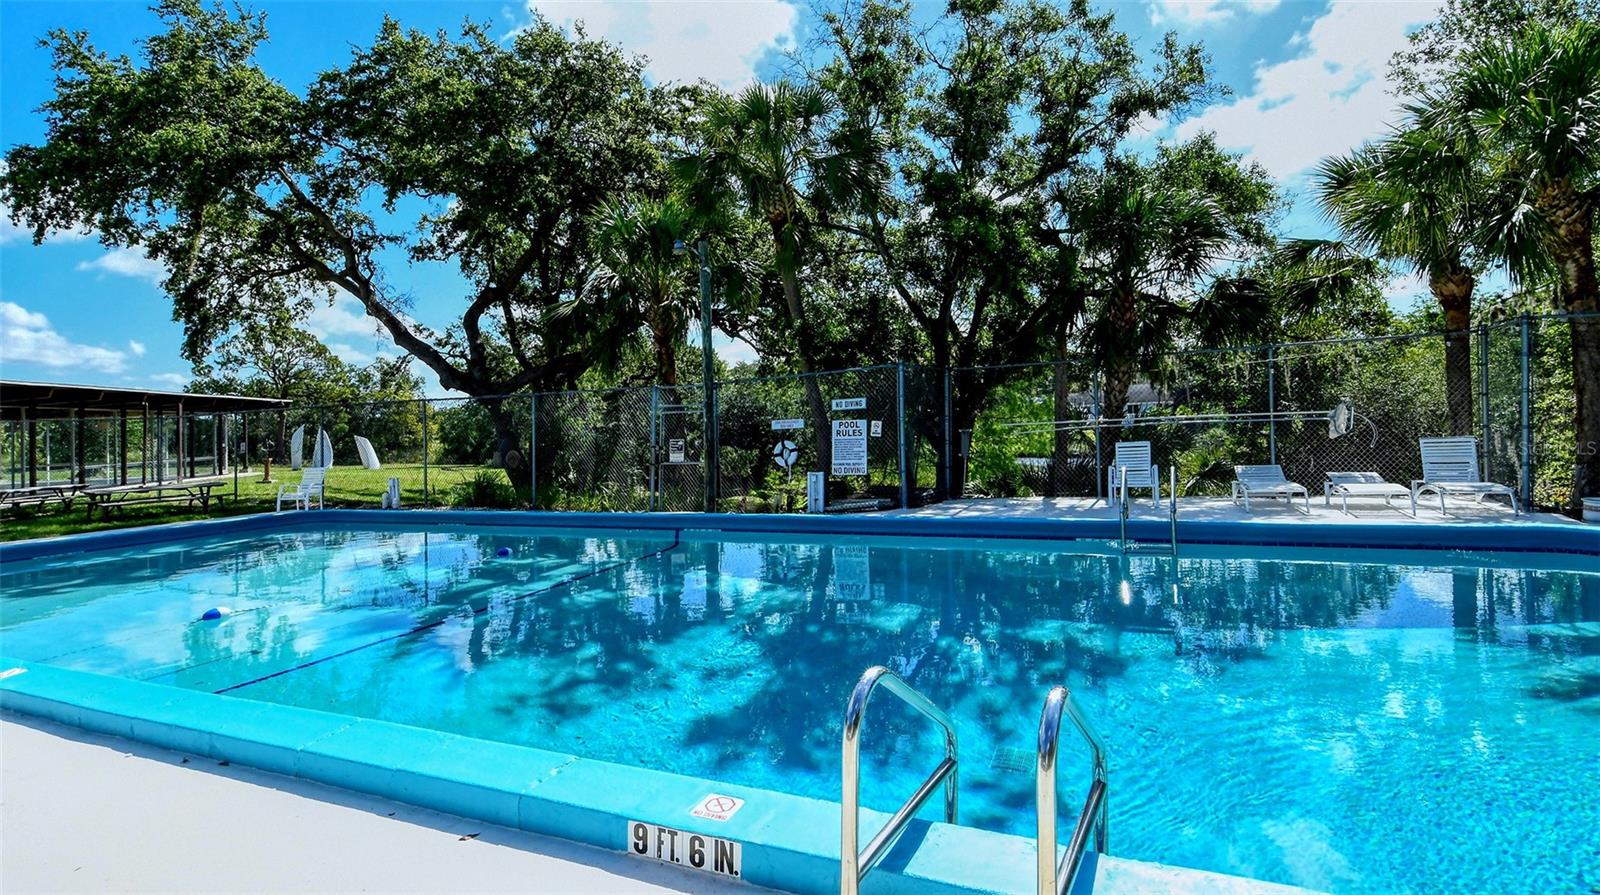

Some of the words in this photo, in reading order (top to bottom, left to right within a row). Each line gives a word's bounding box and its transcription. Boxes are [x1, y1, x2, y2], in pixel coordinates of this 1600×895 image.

[845, 400, 863, 408] DIVING
[839, 421, 860, 429] POOL
[836, 429, 863, 437] RULES
[633, 823, 648, 855] 9
[656, 827, 680, 863] FT.
[689, 835, 705, 868] 6
[714, 839, 740, 876] IN.
